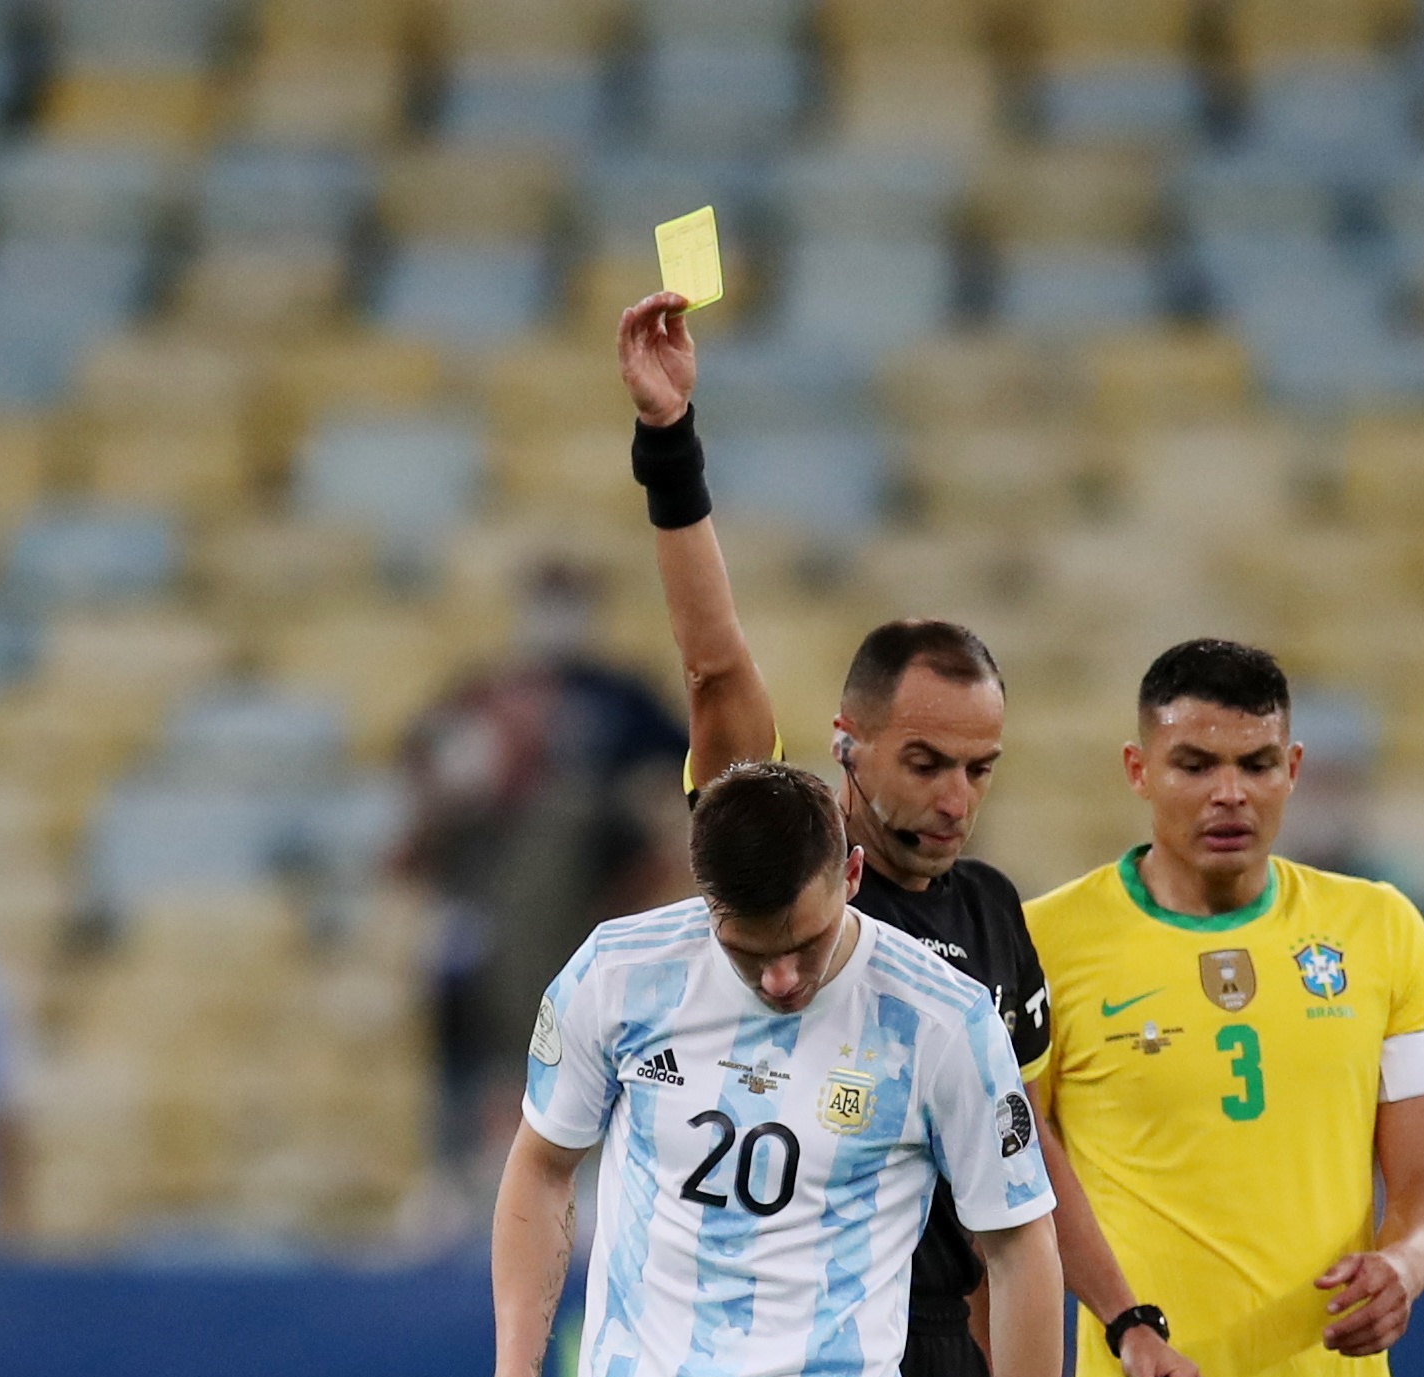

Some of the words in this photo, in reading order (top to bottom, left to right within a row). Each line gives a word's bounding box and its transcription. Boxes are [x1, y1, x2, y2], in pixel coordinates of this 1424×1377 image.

[1306, 1006, 1356, 1019] BRASIL
[636, 1066, 685, 1087] adidas
[1215, 1023, 1266, 1122] 3
[829, 1085, 860, 1118] AFA
[679, 1109, 801, 1217] 20
